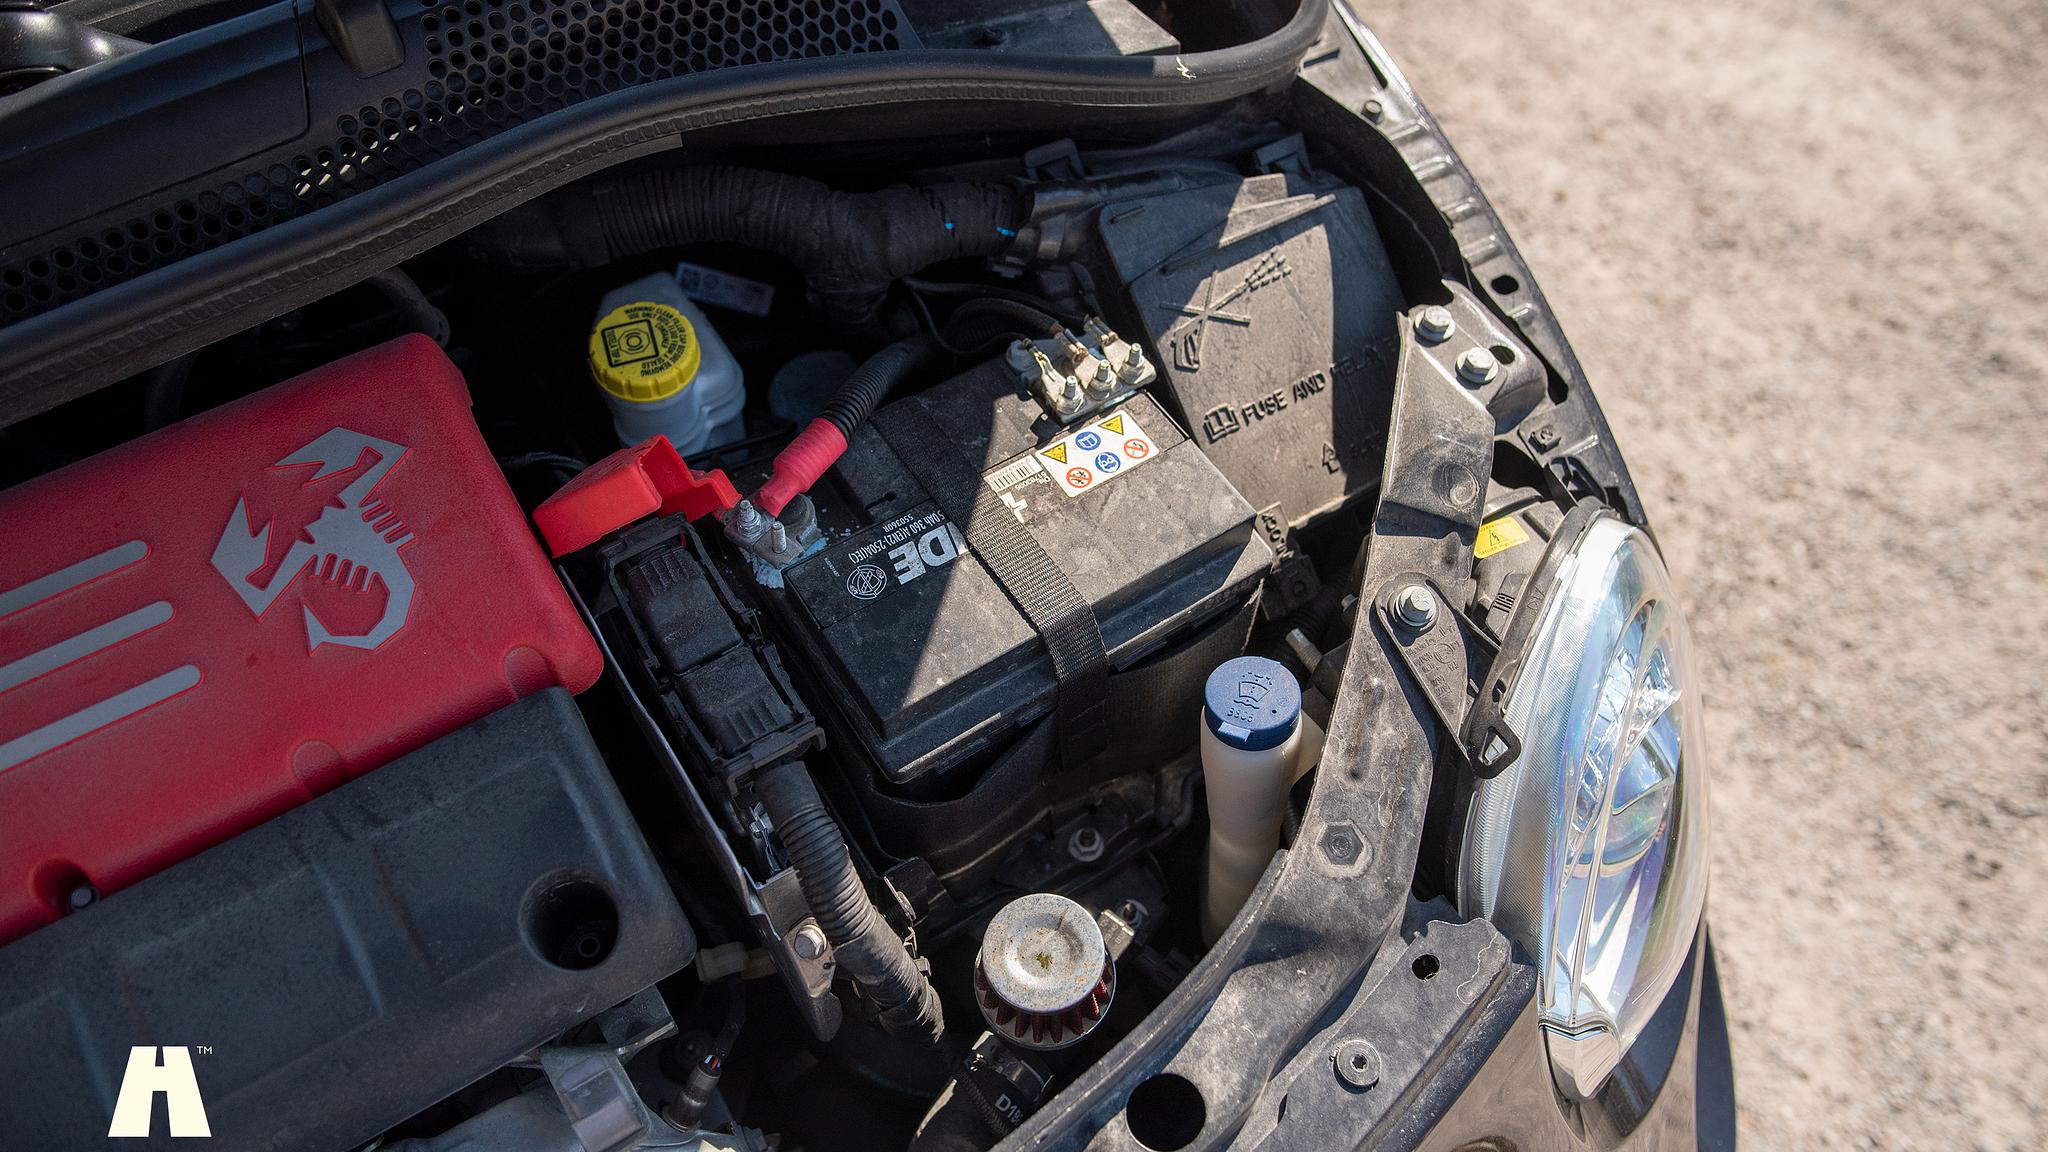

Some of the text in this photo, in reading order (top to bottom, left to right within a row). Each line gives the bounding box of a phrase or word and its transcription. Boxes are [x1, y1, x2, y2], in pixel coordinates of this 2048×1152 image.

[679, 334, 687, 344] CAP
[640, 362, 673, 376] REMOVING
[641, 357, 665, 368] SEALED
[1241, 388, 1288, 427] FUSE
[1292, 370, 1326, 402] AND
[882, 513, 914, 533] 550360R
[911, 518, 927, 535] 360
[888, 521, 970, 585] IDE
[994, 1093, 1024, 1124] D19
